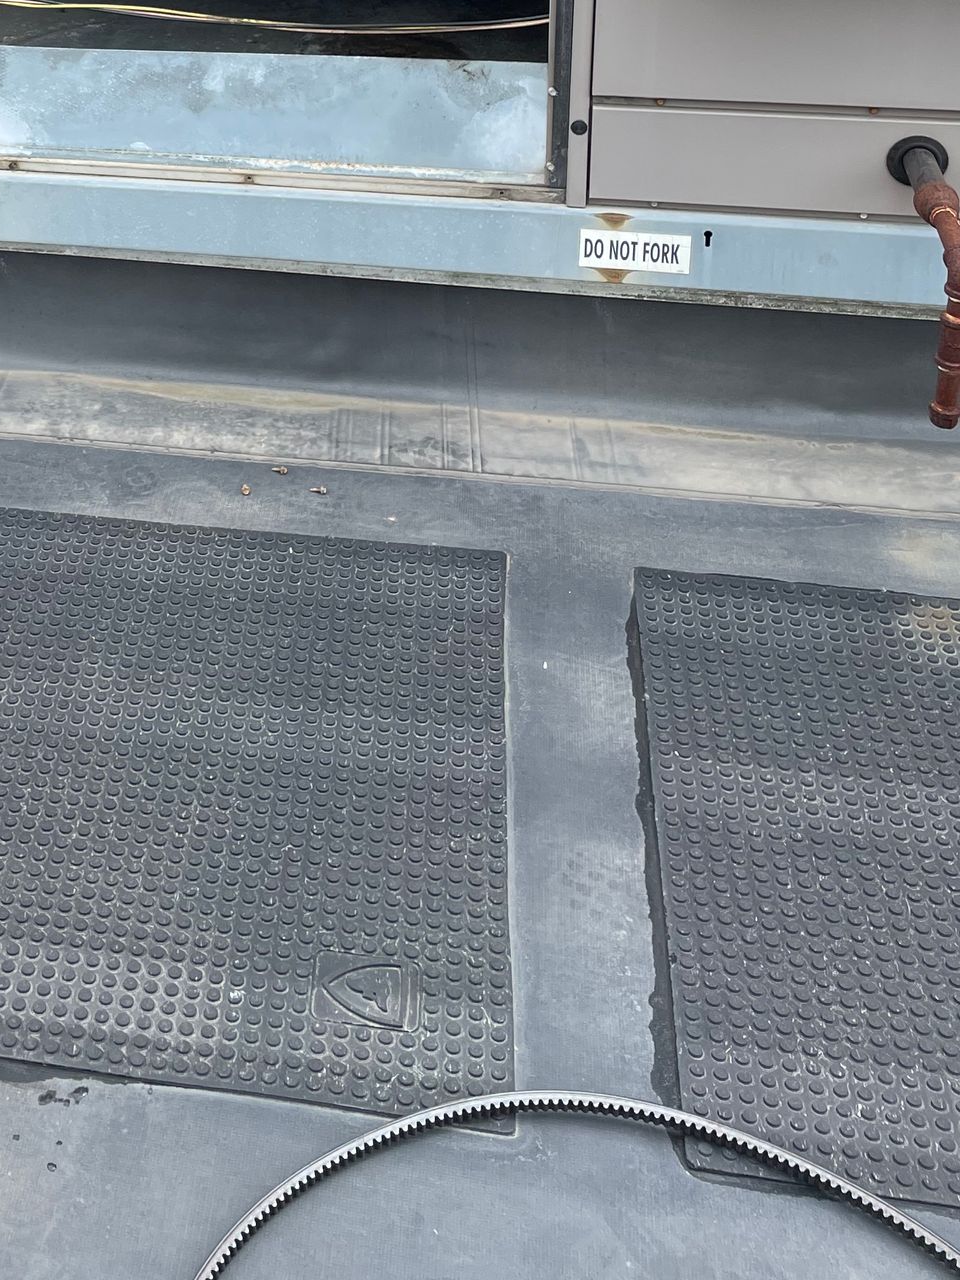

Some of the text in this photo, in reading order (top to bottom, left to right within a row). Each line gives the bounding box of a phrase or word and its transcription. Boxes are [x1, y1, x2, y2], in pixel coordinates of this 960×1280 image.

[584, 238, 680, 264] DO NOT FORK
